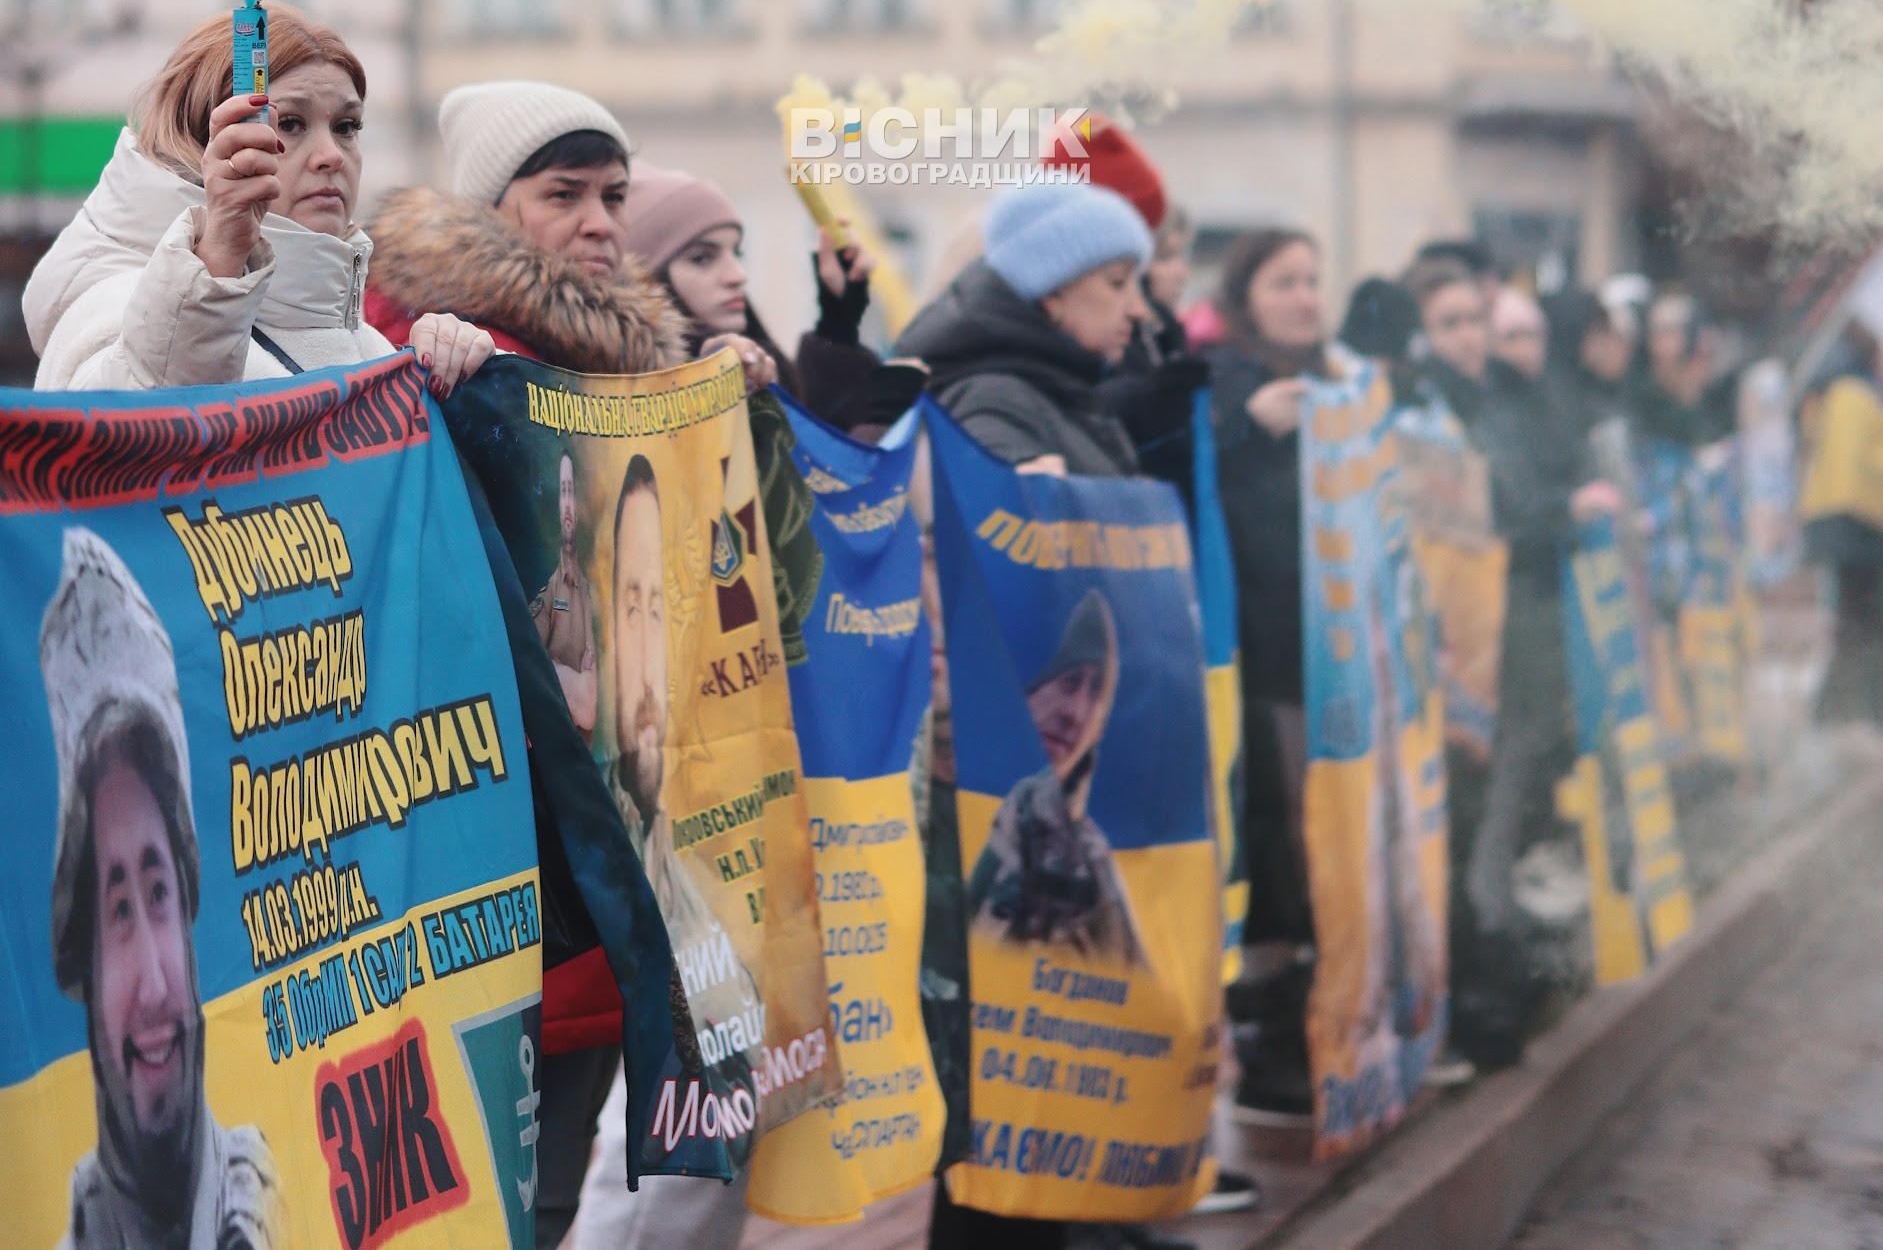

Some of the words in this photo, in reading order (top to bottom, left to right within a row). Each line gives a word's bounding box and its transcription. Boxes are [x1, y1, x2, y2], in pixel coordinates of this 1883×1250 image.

[526, 381, 632, 438] НАЦІОНАЛЬНА
[631, 382, 691, 439] ГВАРДІЯ
[161, 494, 353, 628] Дубинець
[217, 606, 367, 742] Олександр
[229, 692, 508, 879] Володимирович
[262, 980, 294, 1064] 35
[349, 948, 375, 1015] 1
[420, 880, 542, 981] БАТАРЕЯ
